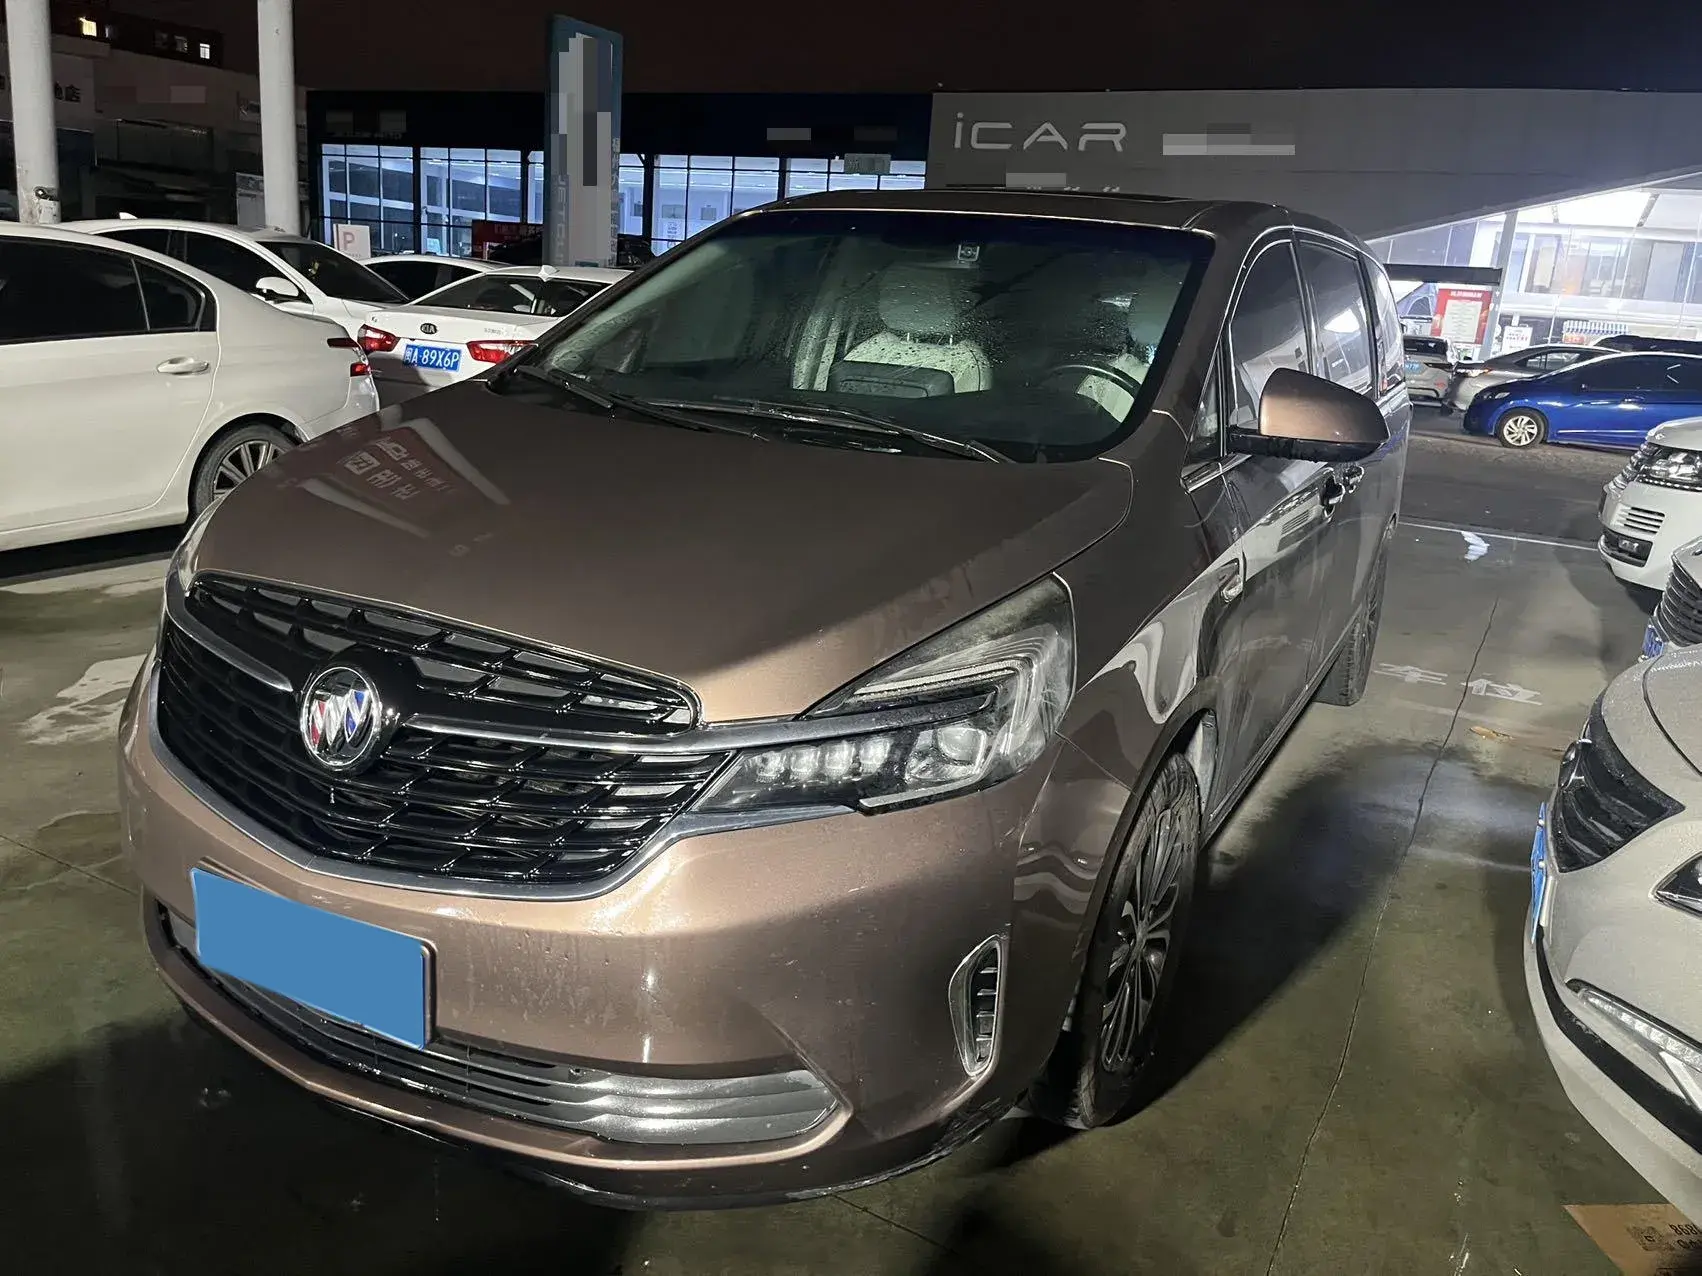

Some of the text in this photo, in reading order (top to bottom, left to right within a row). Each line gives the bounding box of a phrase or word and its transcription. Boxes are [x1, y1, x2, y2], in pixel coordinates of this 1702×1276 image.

[954, 112, 1127, 152] iCAR
[343, 231, 356, 251] P
[421, 323, 437, 334] KIA
